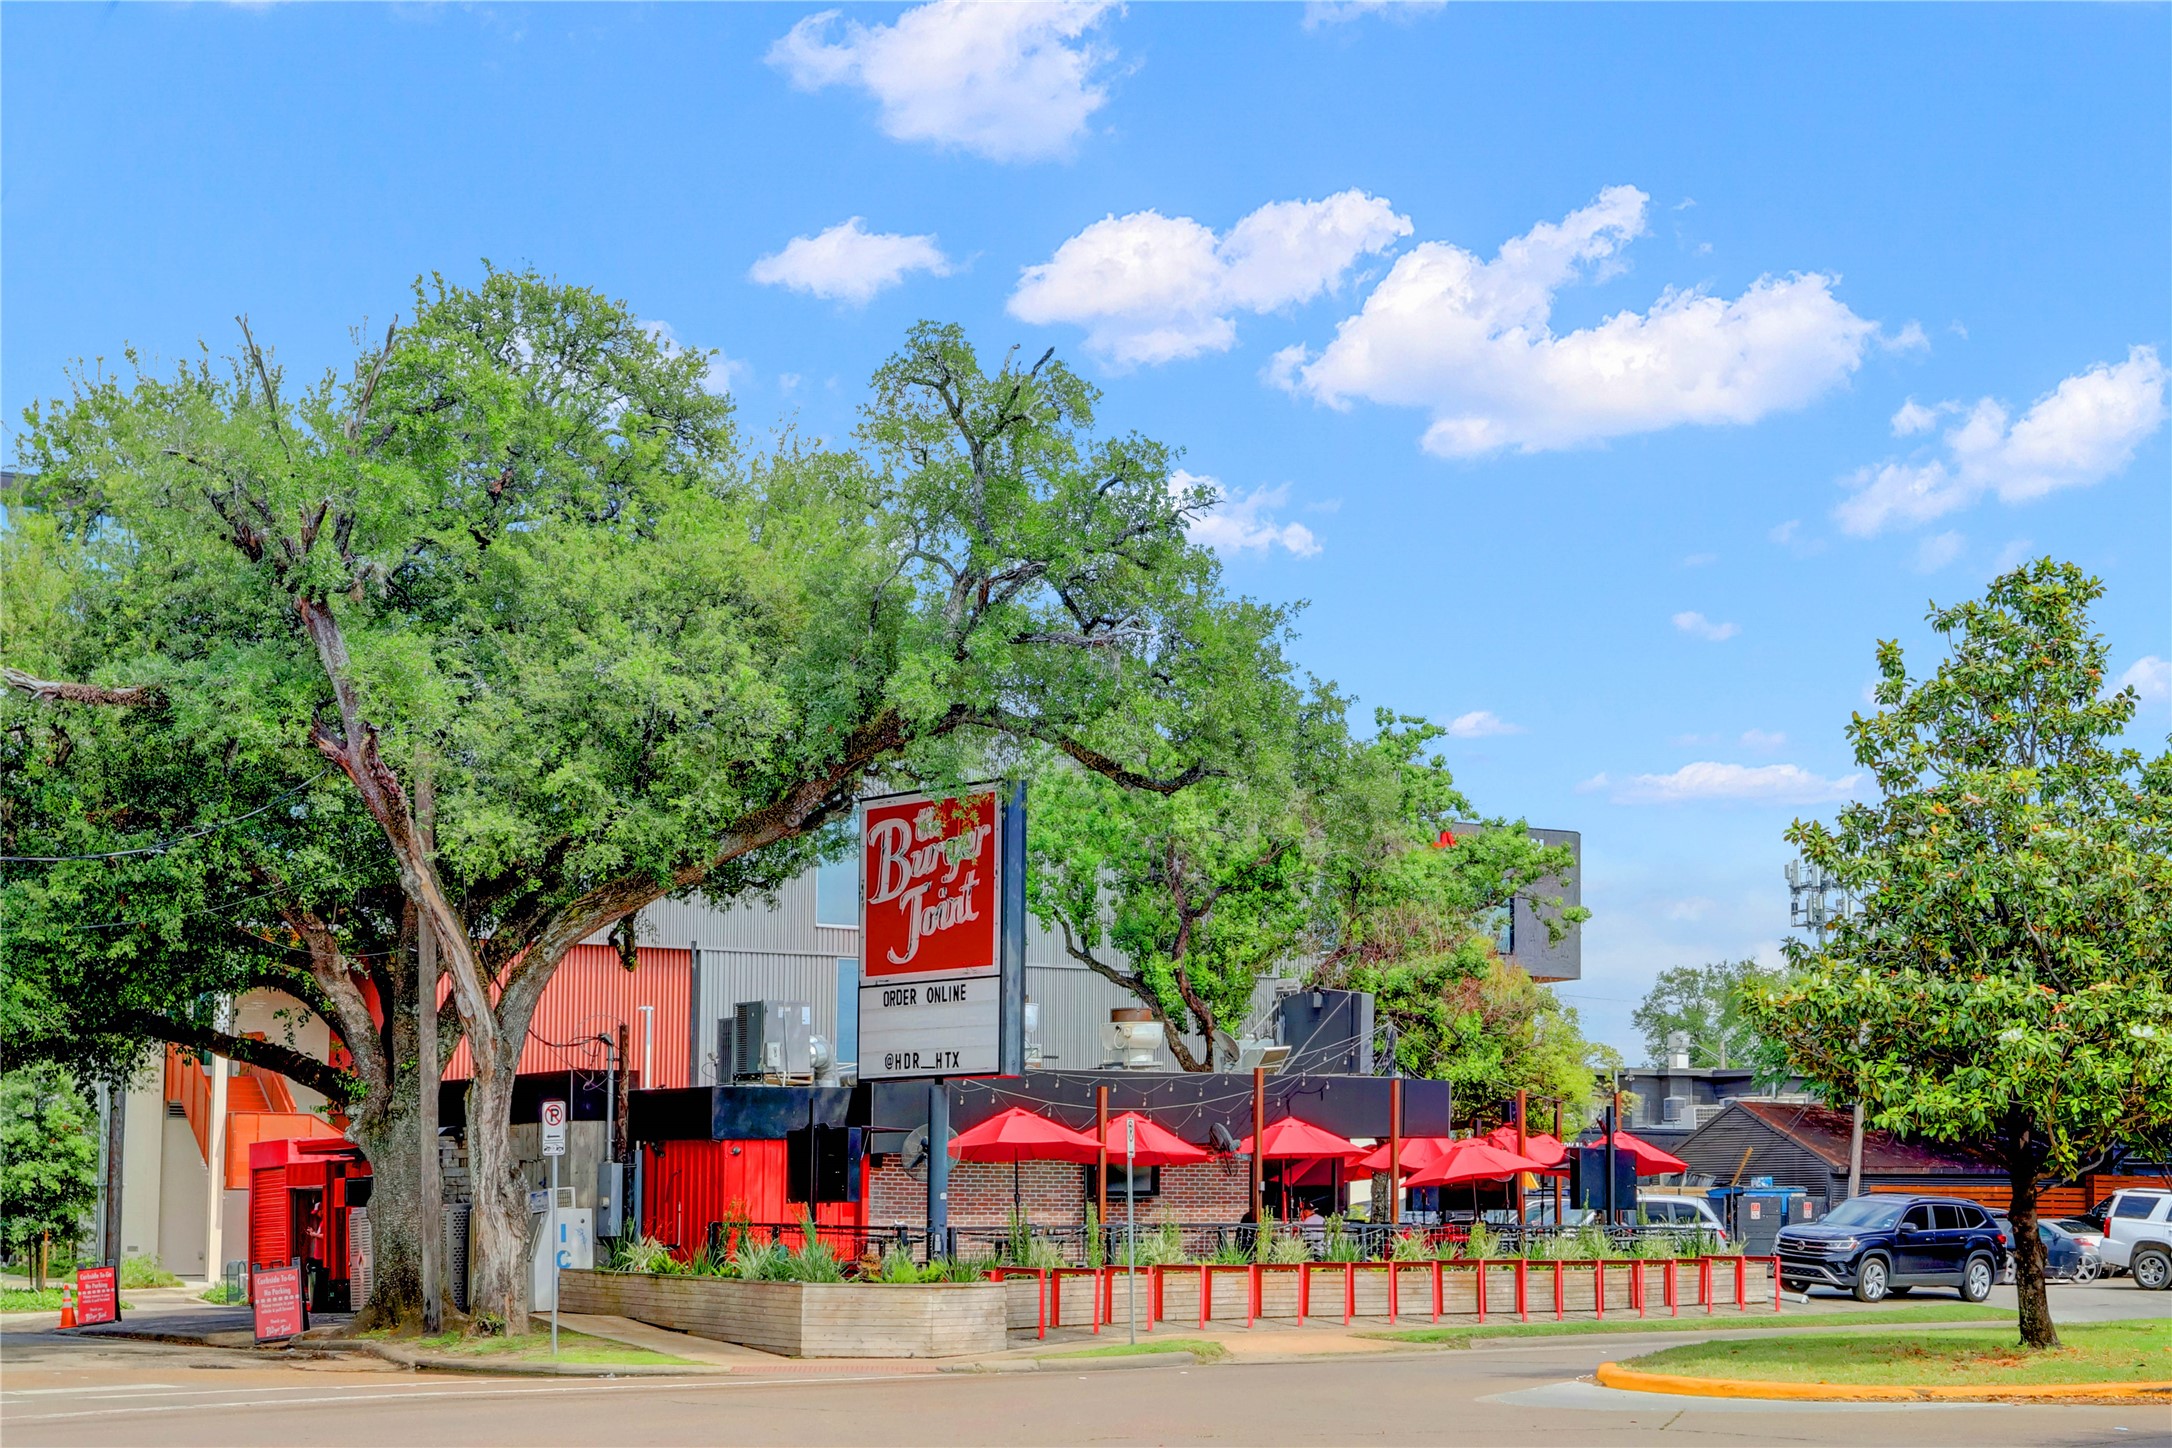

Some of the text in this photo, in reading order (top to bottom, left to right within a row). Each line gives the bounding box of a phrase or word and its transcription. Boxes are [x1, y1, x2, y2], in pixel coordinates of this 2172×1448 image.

[868, 818, 991, 904] Burger
[887, 870, 980, 964] Joint
[883, 984, 966, 1007] ORDER ONLINE
[257, 1276, 280, 1284] Curbside
[272, 1287, 291, 1295] Parking
